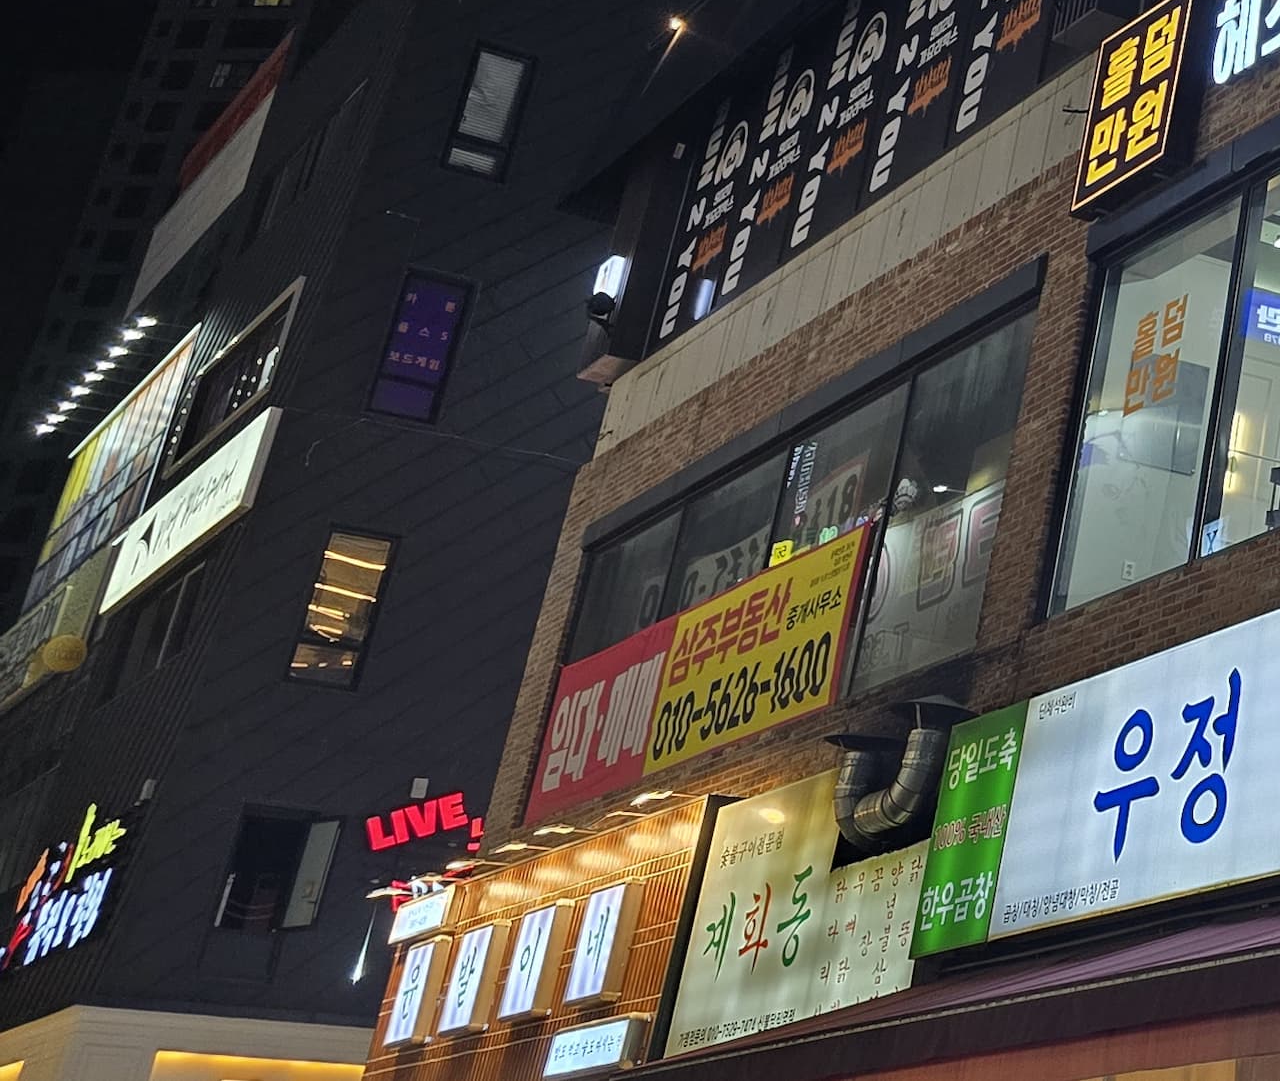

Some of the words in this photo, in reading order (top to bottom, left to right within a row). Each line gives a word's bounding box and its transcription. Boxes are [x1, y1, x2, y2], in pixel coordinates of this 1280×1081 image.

[956, 10, 998, 134] YOU
[1099, 5, 1182, 109] 홀덤
[868, 76, 911, 193] YOU
[1085, 79, 1167, 188] 만원
[667, 576, 794, 688] 삼주부동산
[785, 585, 843, 631] 중개사무소
[651, 630, 833, 762] 010-5626-1600
[947, 726, 1019, 791] 당일도축
[1093, 666, 1243, 864] 우정
[720, 827, 786, 868] 숯불구이전문점
[932, 816, 967, 851] 100%
[967, 803, 1008, 844] 국내산
[919, 870, 994, 932] 한우곱창
[1002, 878, 1121, 925] 곱창/대창/양념대창/막창/전골
